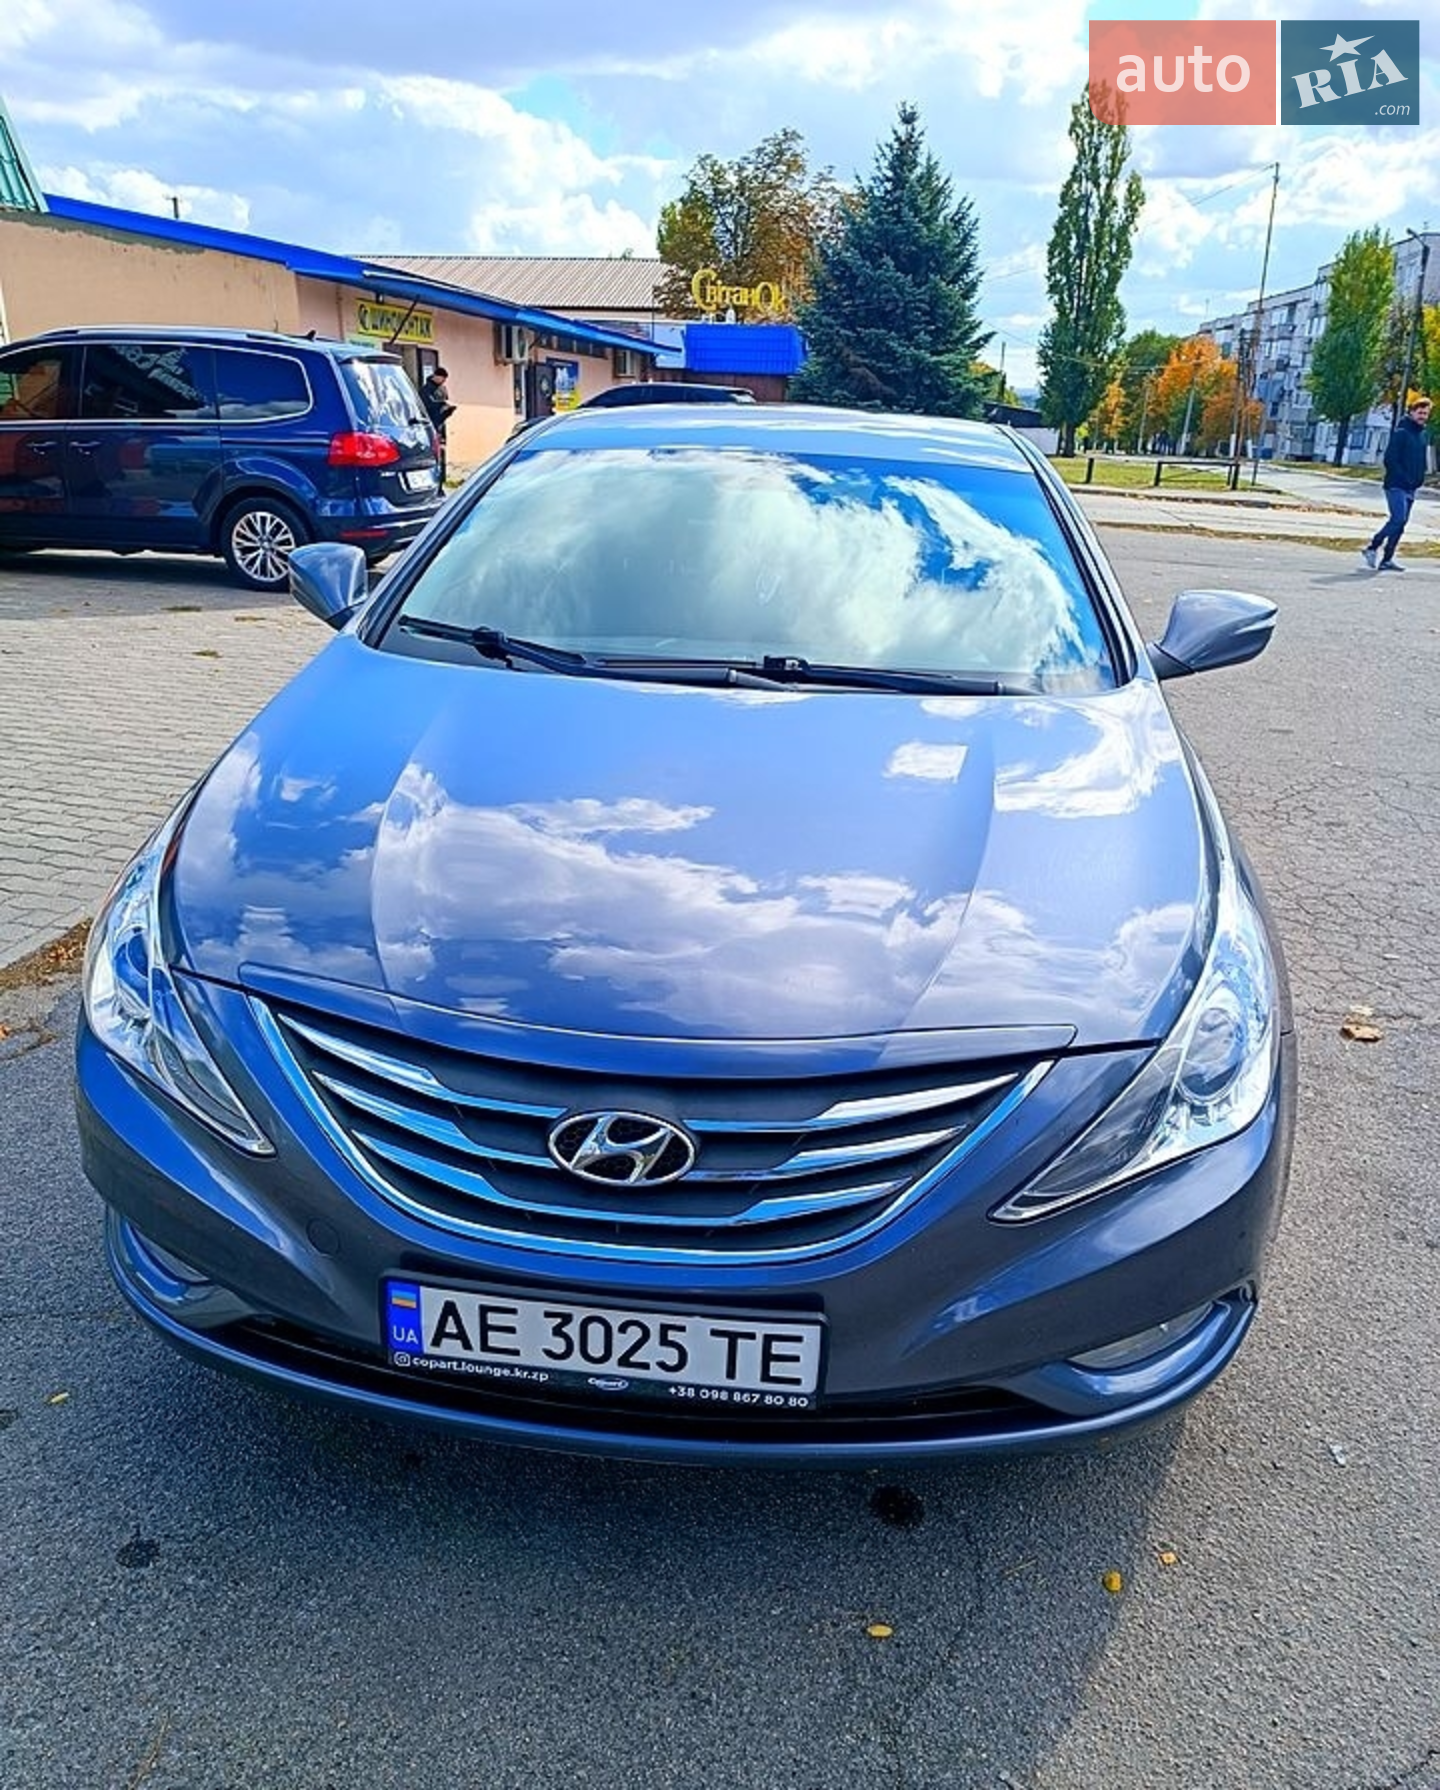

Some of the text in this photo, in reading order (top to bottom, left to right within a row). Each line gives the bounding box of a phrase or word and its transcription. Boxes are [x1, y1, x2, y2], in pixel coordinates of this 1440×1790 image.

[392, 1325, 419, 1345] UA
[430, 1299, 804, 1386] AE 3025 TE
[412, 1357, 549, 1383] copart.lounge.kr.zp
[669, 1385, 809, 1408] +38 098 867 80 80
